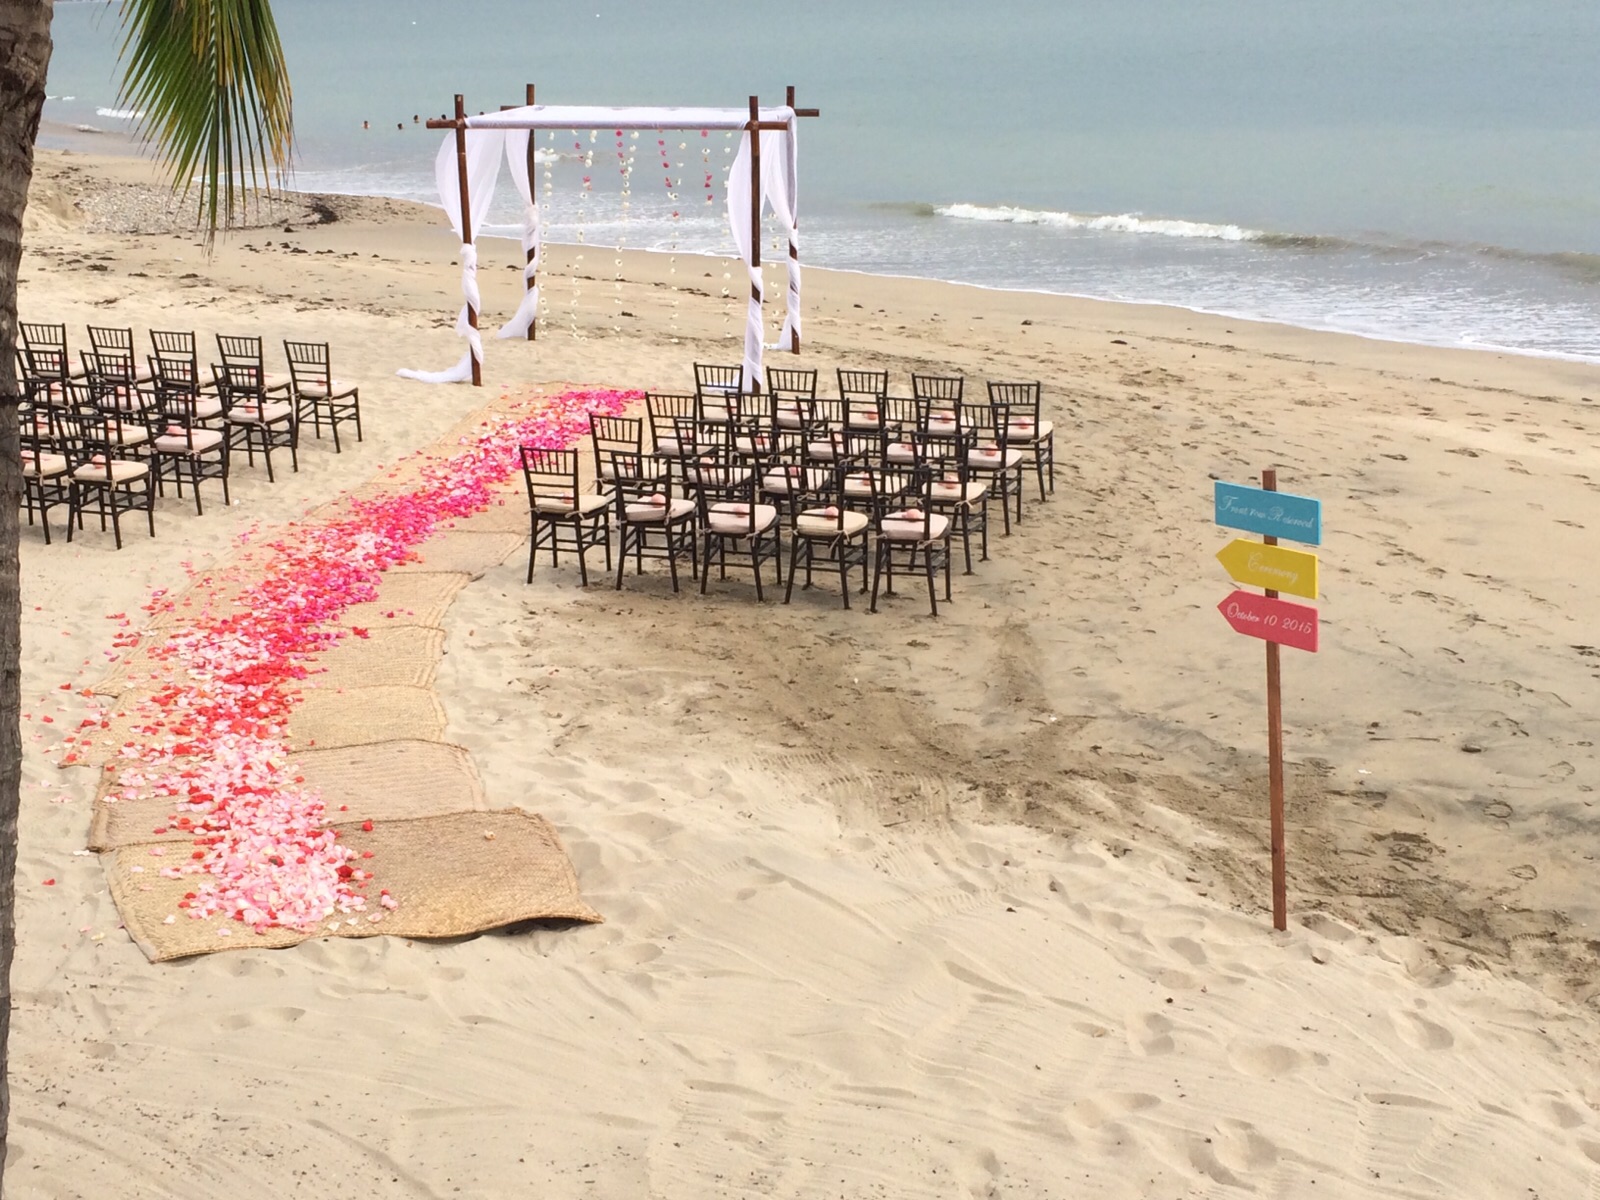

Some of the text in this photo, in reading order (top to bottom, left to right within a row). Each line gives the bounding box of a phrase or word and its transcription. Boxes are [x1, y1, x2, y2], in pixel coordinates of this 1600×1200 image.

[1267, 506, 1314, 528] Reserved
[1247, 551, 1298, 586] Ceremony
[1227, 602, 1313, 634] October 10 2015
